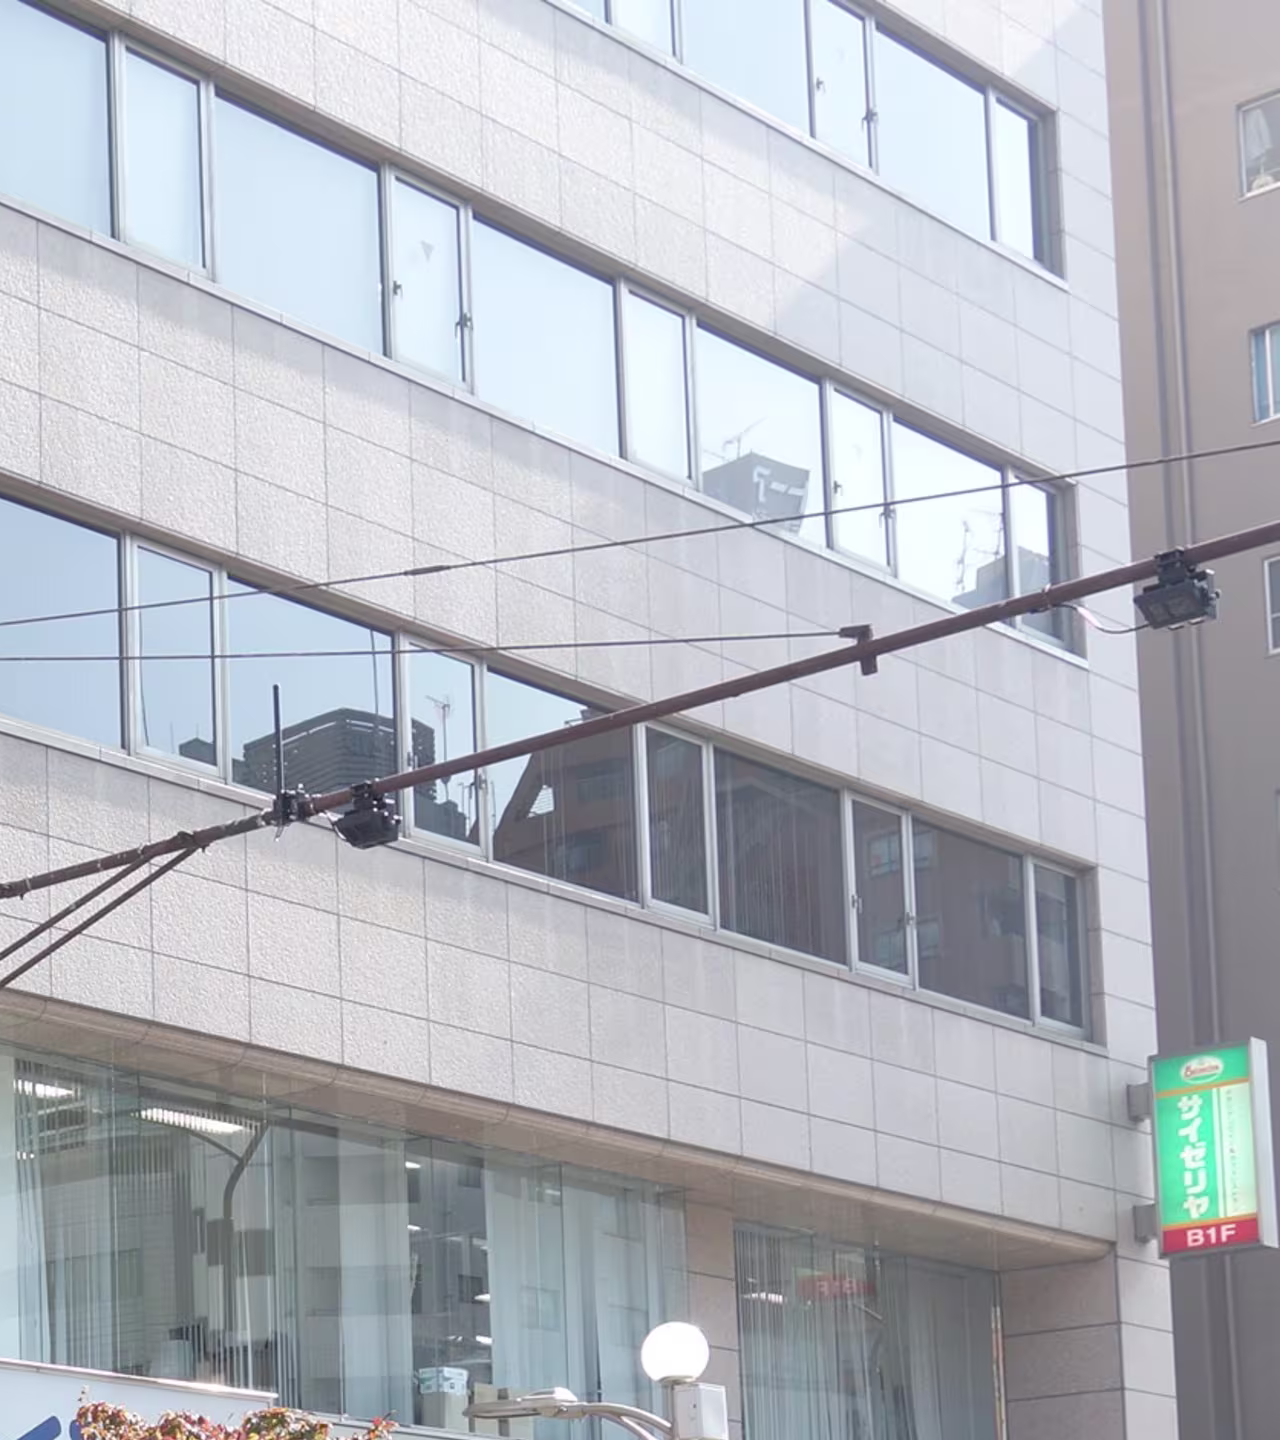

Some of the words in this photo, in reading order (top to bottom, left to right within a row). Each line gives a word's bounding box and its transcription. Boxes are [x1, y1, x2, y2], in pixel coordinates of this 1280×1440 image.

[1177, 1094, 1210, 1219] サイゼリヤ
[1186, 1224, 1237, 1247] B1F
